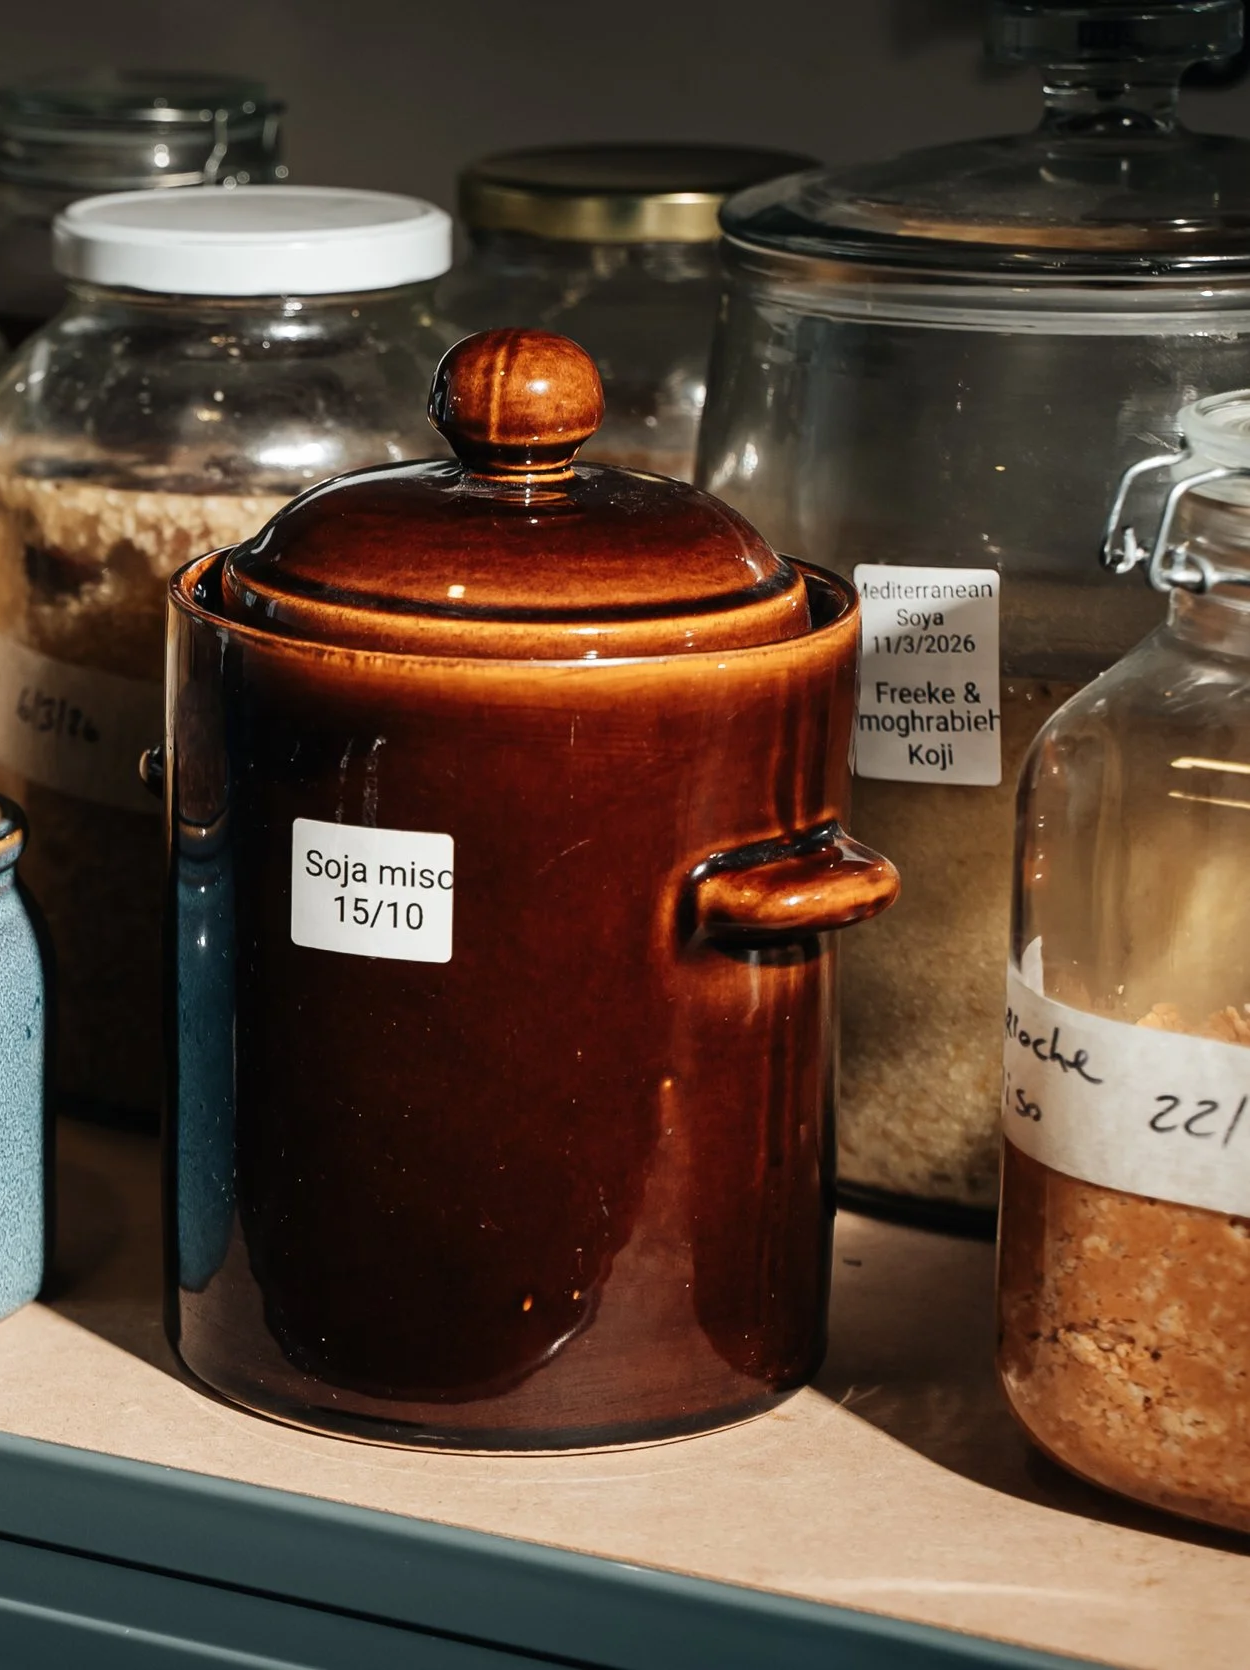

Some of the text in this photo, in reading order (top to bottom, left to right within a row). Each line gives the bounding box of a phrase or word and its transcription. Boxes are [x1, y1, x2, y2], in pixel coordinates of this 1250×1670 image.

[896, 608, 944, 631] Soya
[874, 634, 976, 655] 11/3/2026
[875, 681, 981, 704] Freeke &
[908, 743, 953, 771] Koji
[305, 849, 453, 890] Soja miso
[334, 895, 423, 930] 15/10
